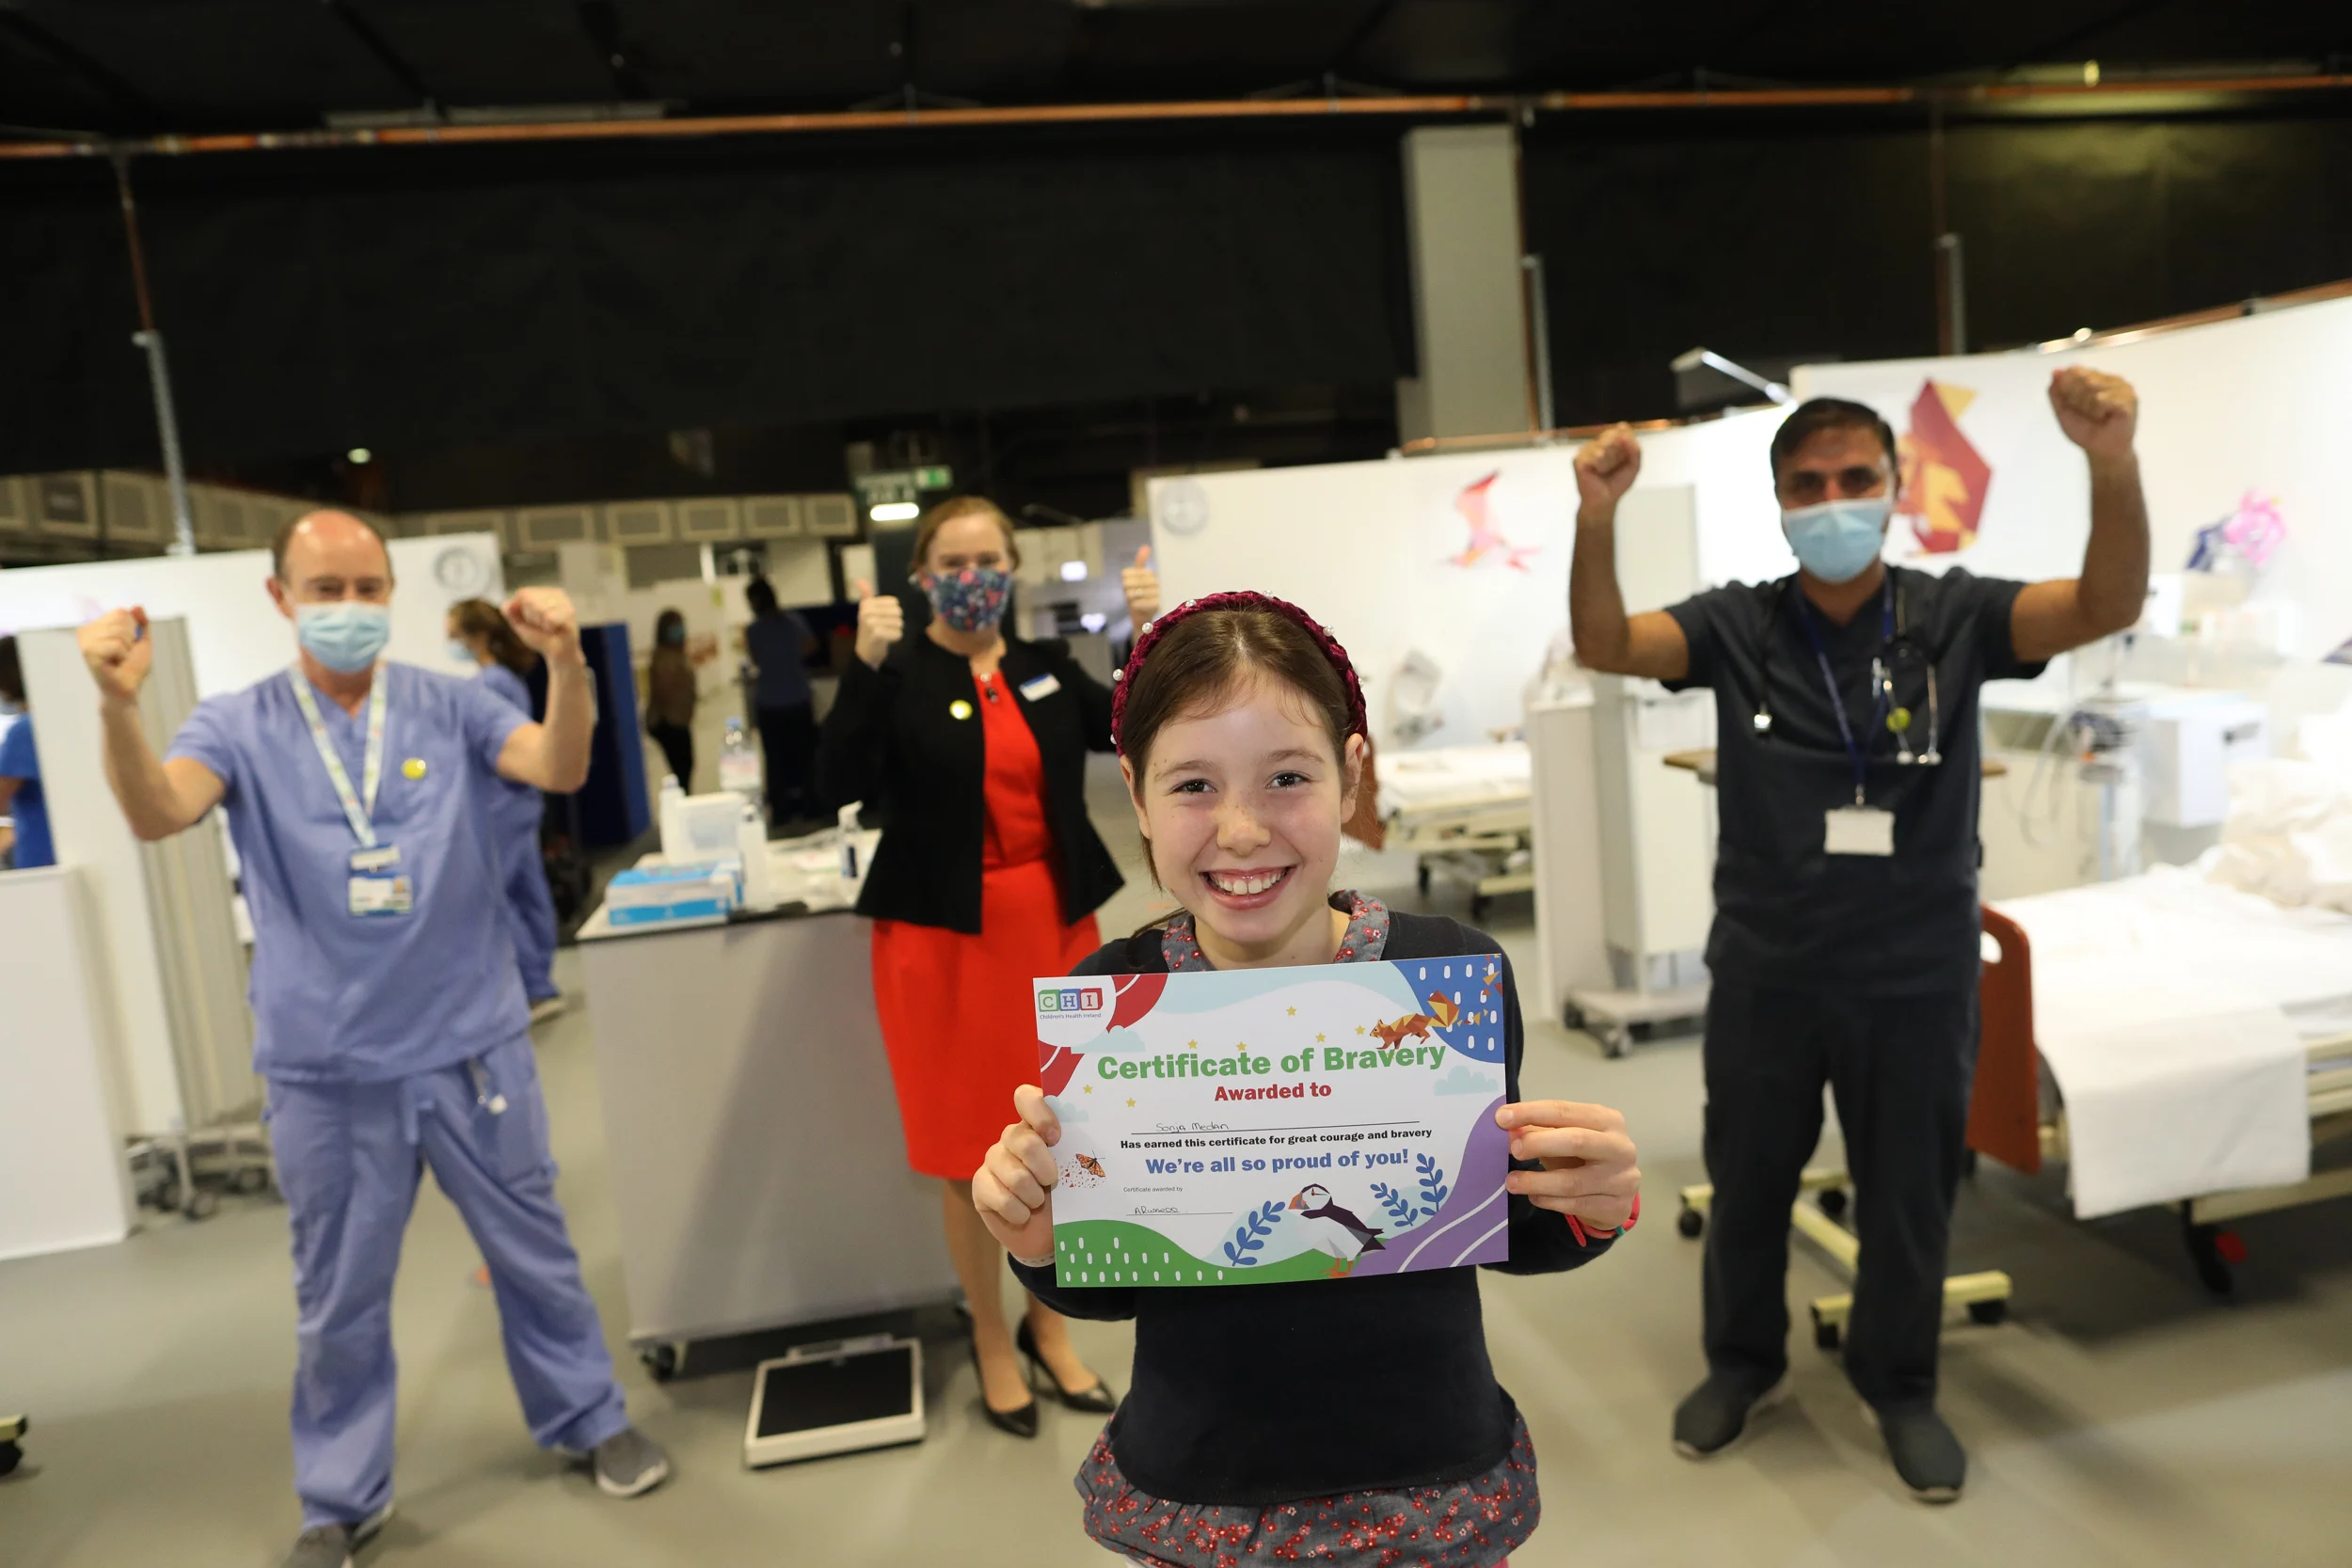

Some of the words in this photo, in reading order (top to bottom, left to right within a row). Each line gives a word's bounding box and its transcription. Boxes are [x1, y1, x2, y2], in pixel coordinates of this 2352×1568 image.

[1042, 994, 1093, 1008] CHI
[1098, 1053, 1271, 1079] Certificate
[1280, 1047, 1314, 1073] of
[1324, 1046, 1446, 1070] Bravery
[1215, 1083, 1304, 1101] Awarded
[1310, 1083, 1332, 1097] to
[1120, 1140, 1141, 1148] Has
[1144, 1139, 1183, 1148] earned
[1184, 1138, 1206, 1148] this
[1209, 1136, 1266, 1146] certificate
[1269, 1135, 1285, 1144] for
[1288, 1133, 1317, 1145] great
[1320, 1133, 1364, 1142] courage
[1367, 1131, 1388, 1139] and
[1391, 1130, 1432, 1138] bravery
[1145, 1158, 1204, 1174] We're
[1210, 1157, 1235, 1172] all
[1241, 1159, 1266, 1171] so
[1272, 1152, 1332, 1173] proud
[1338, 1150, 1360, 1166] of
[1365, 1148, 1408, 1169] you!
